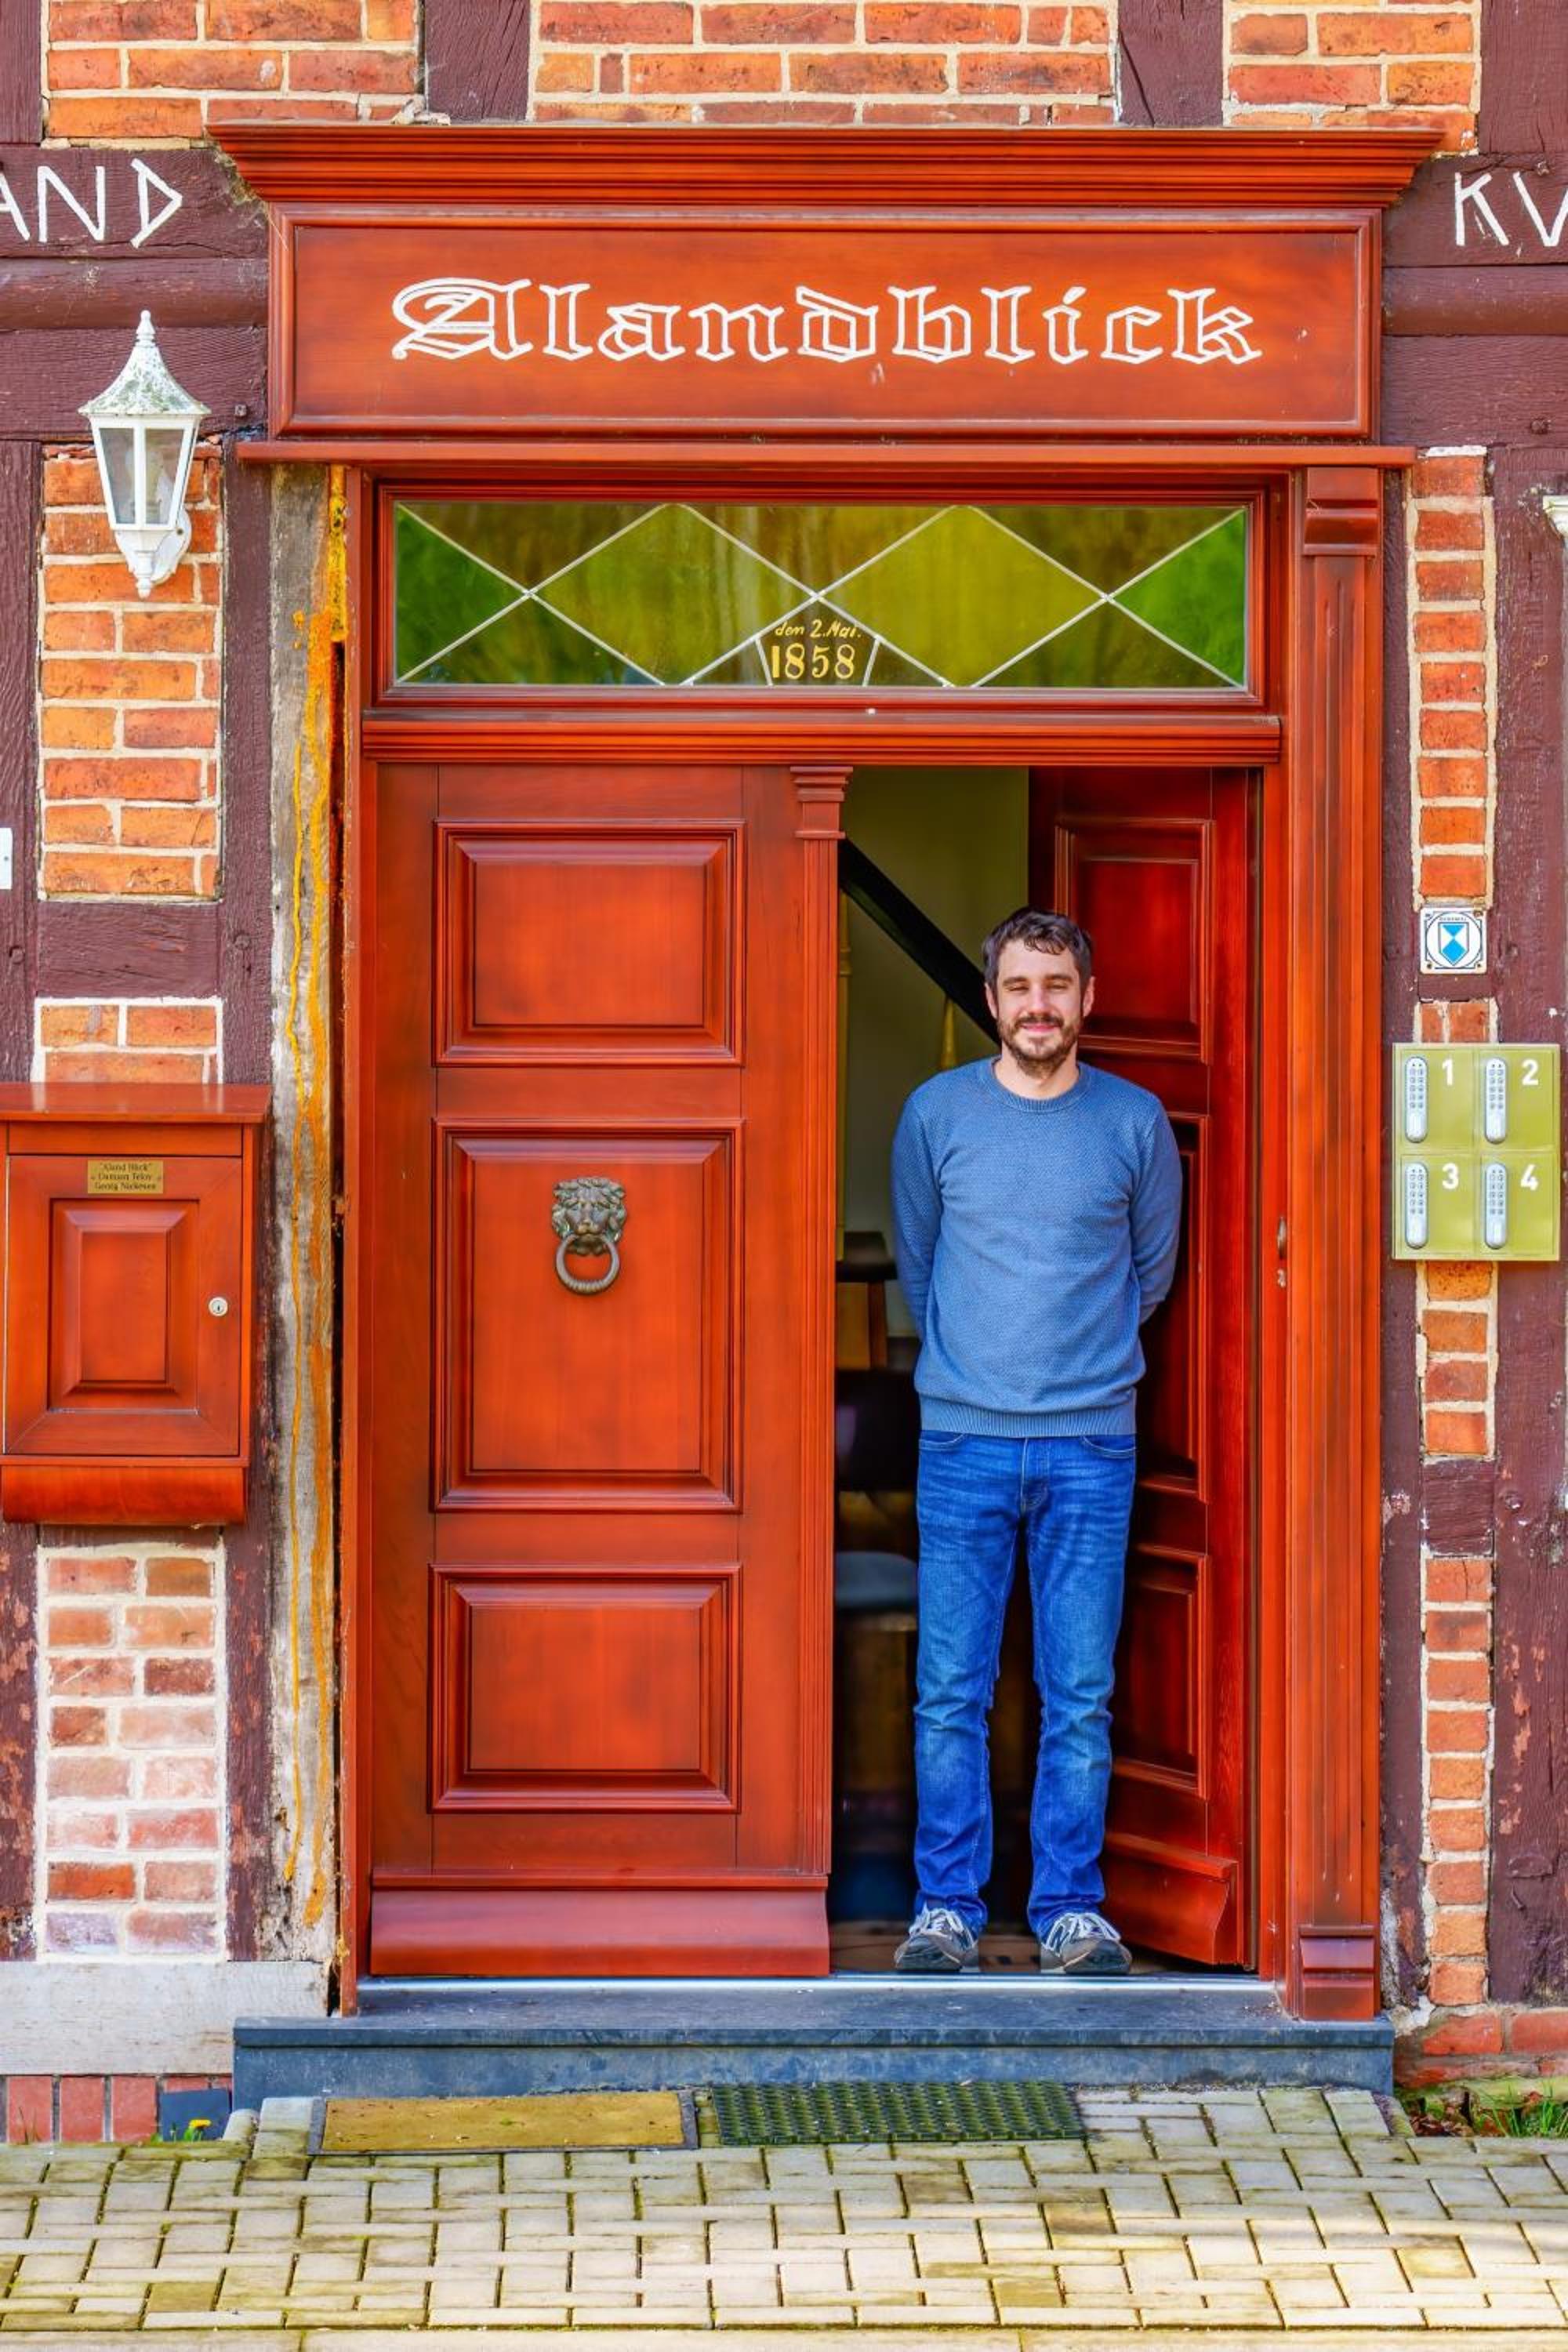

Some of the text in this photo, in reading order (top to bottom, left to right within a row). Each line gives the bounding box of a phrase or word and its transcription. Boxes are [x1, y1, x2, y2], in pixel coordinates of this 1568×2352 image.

[392, 278, 1263, 365] Alandblick
[771, 643, 855, 680] 1858
[1443, 1059, 1454, 1086] 1
[1522, 1059, 1539, 1086] 2
[1442, 1163, 1459, 1189] 3
[1520, 1163, 1539, 1191] 4
